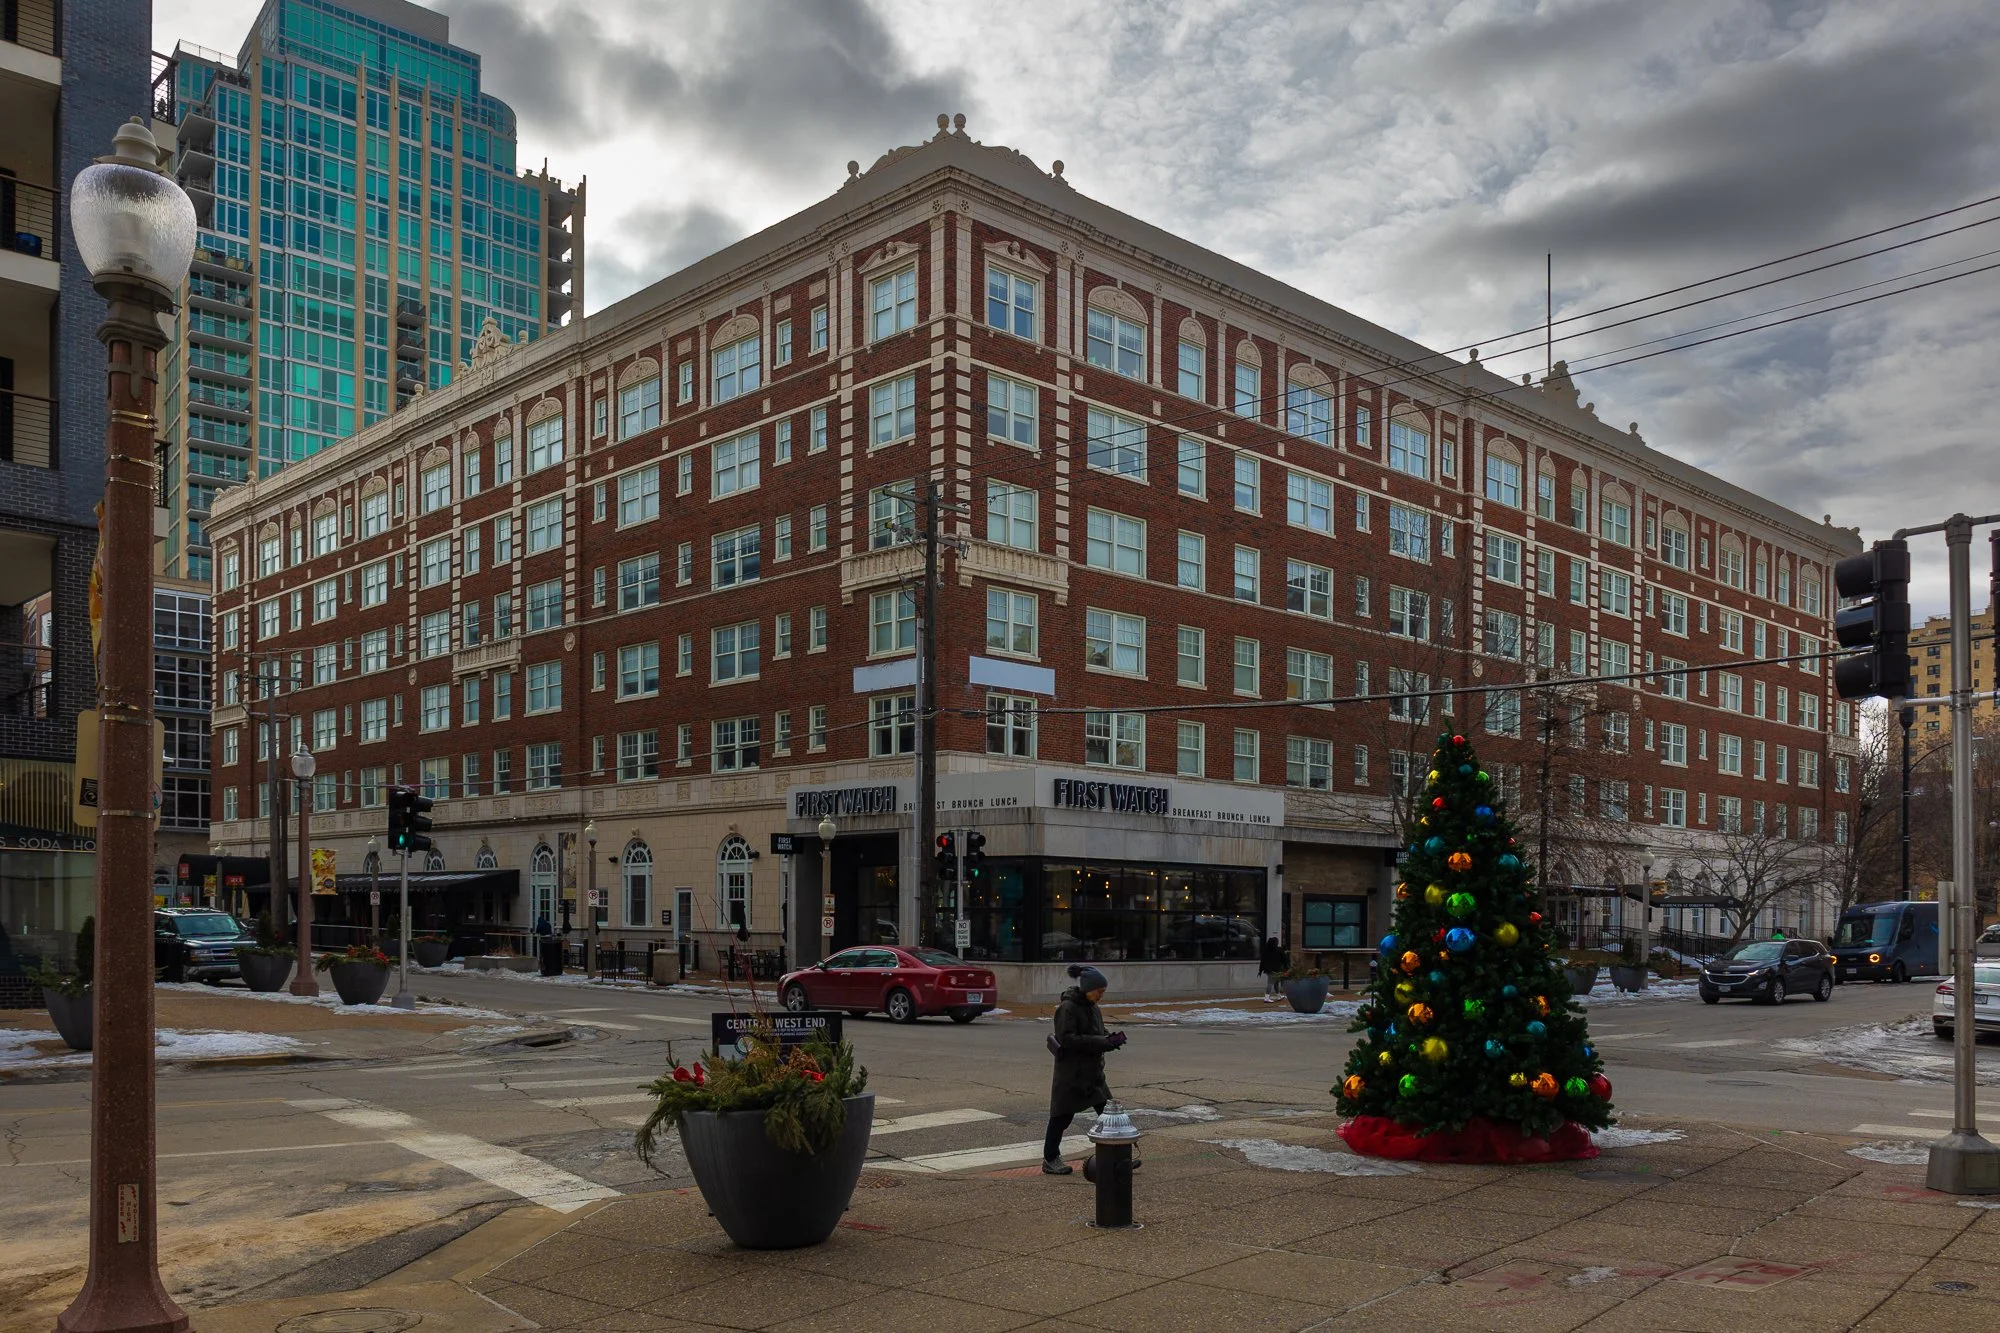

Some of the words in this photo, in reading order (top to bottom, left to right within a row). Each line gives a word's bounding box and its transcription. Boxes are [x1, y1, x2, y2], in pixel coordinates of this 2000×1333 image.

[796, 790, 840, 816] FIRST
[840, 786, 896, 814] WATCH
[1054, 778, 1108, 809] FIRST
[1109, 783, 1168, 814] WATCH
[951, 799, 984, 809] BRUNCH
[991, 797, 1018, 806] LUNCH
[1172, 808, 1211, 819] BREAKFAST
[1217, 812, 1244, 821] BRUNCH
[1250, 814, 1271, 823] LUNCH
[18, 838, 61, 849] SODA
[775, 1017, 802, 1029] WEST
[805, 1017, 826, 1028] END
